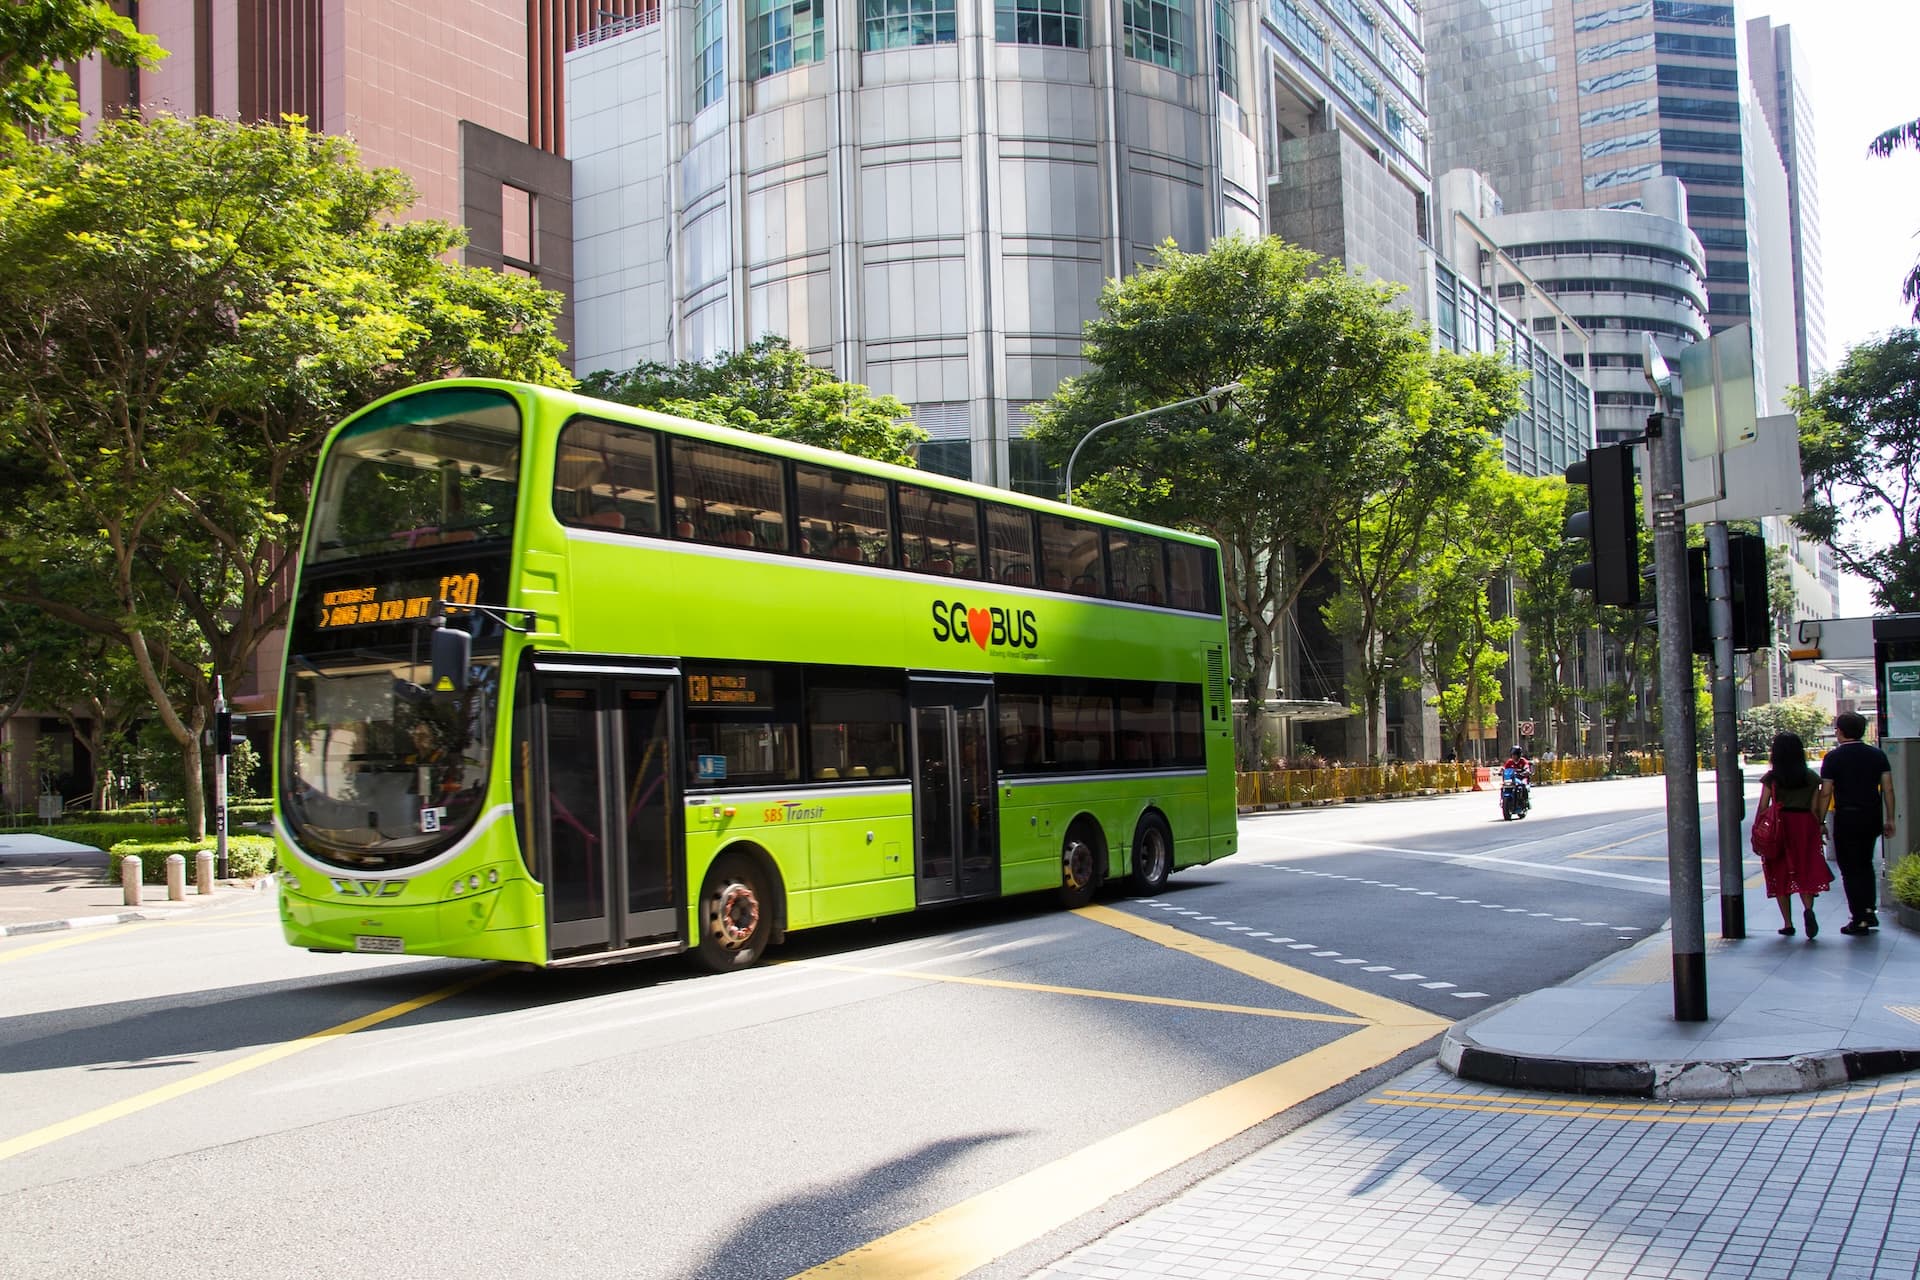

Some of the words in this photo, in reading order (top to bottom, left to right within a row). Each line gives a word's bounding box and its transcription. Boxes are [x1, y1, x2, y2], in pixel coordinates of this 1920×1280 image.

[440, 573, 479, 613] 130
[989, 606, 1038, 648] BUS
[688, 675, 709, 702] 130
[763, 808, 783, 823] SBS
[783, 803, 826, 822] Transit
